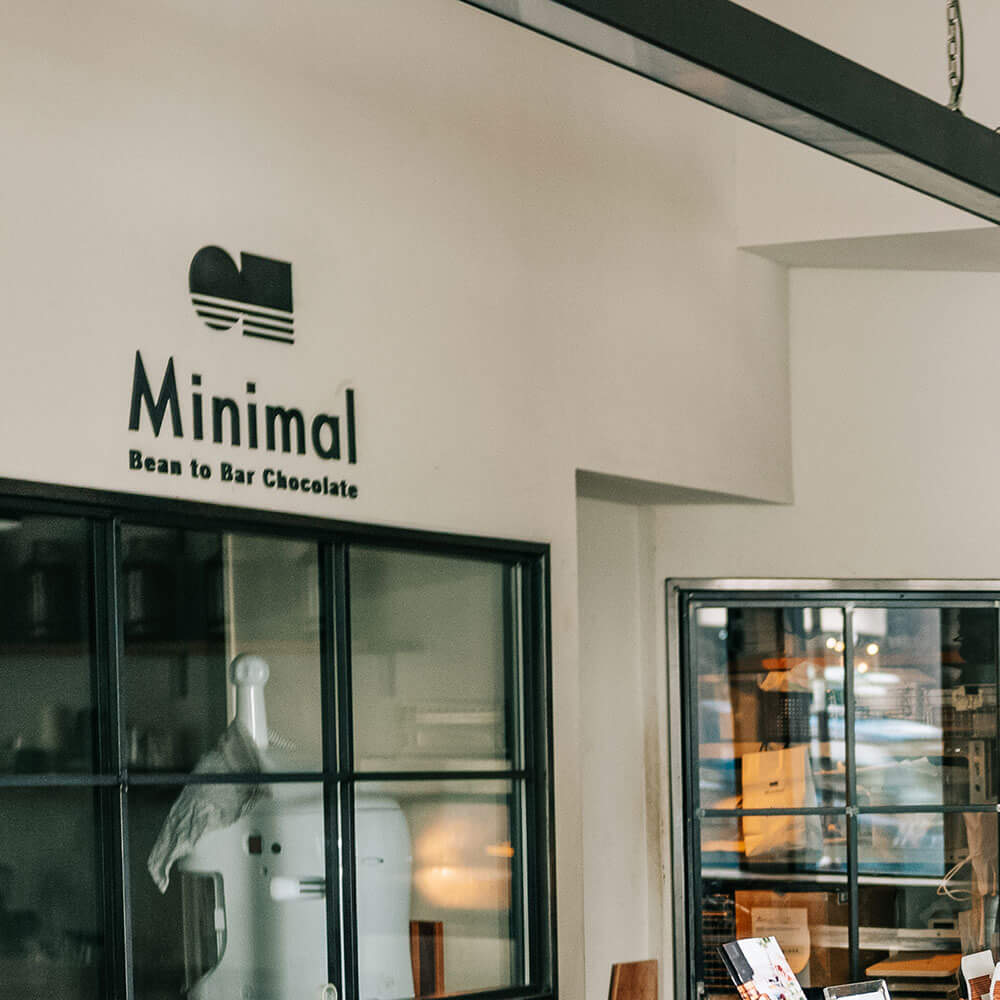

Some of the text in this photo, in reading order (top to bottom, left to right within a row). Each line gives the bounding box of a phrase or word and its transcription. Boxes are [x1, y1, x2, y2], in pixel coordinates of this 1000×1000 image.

[128, 349, 357, 464] Minimal
[129, 449, 358, 499] Bean to Bar Chocolate
